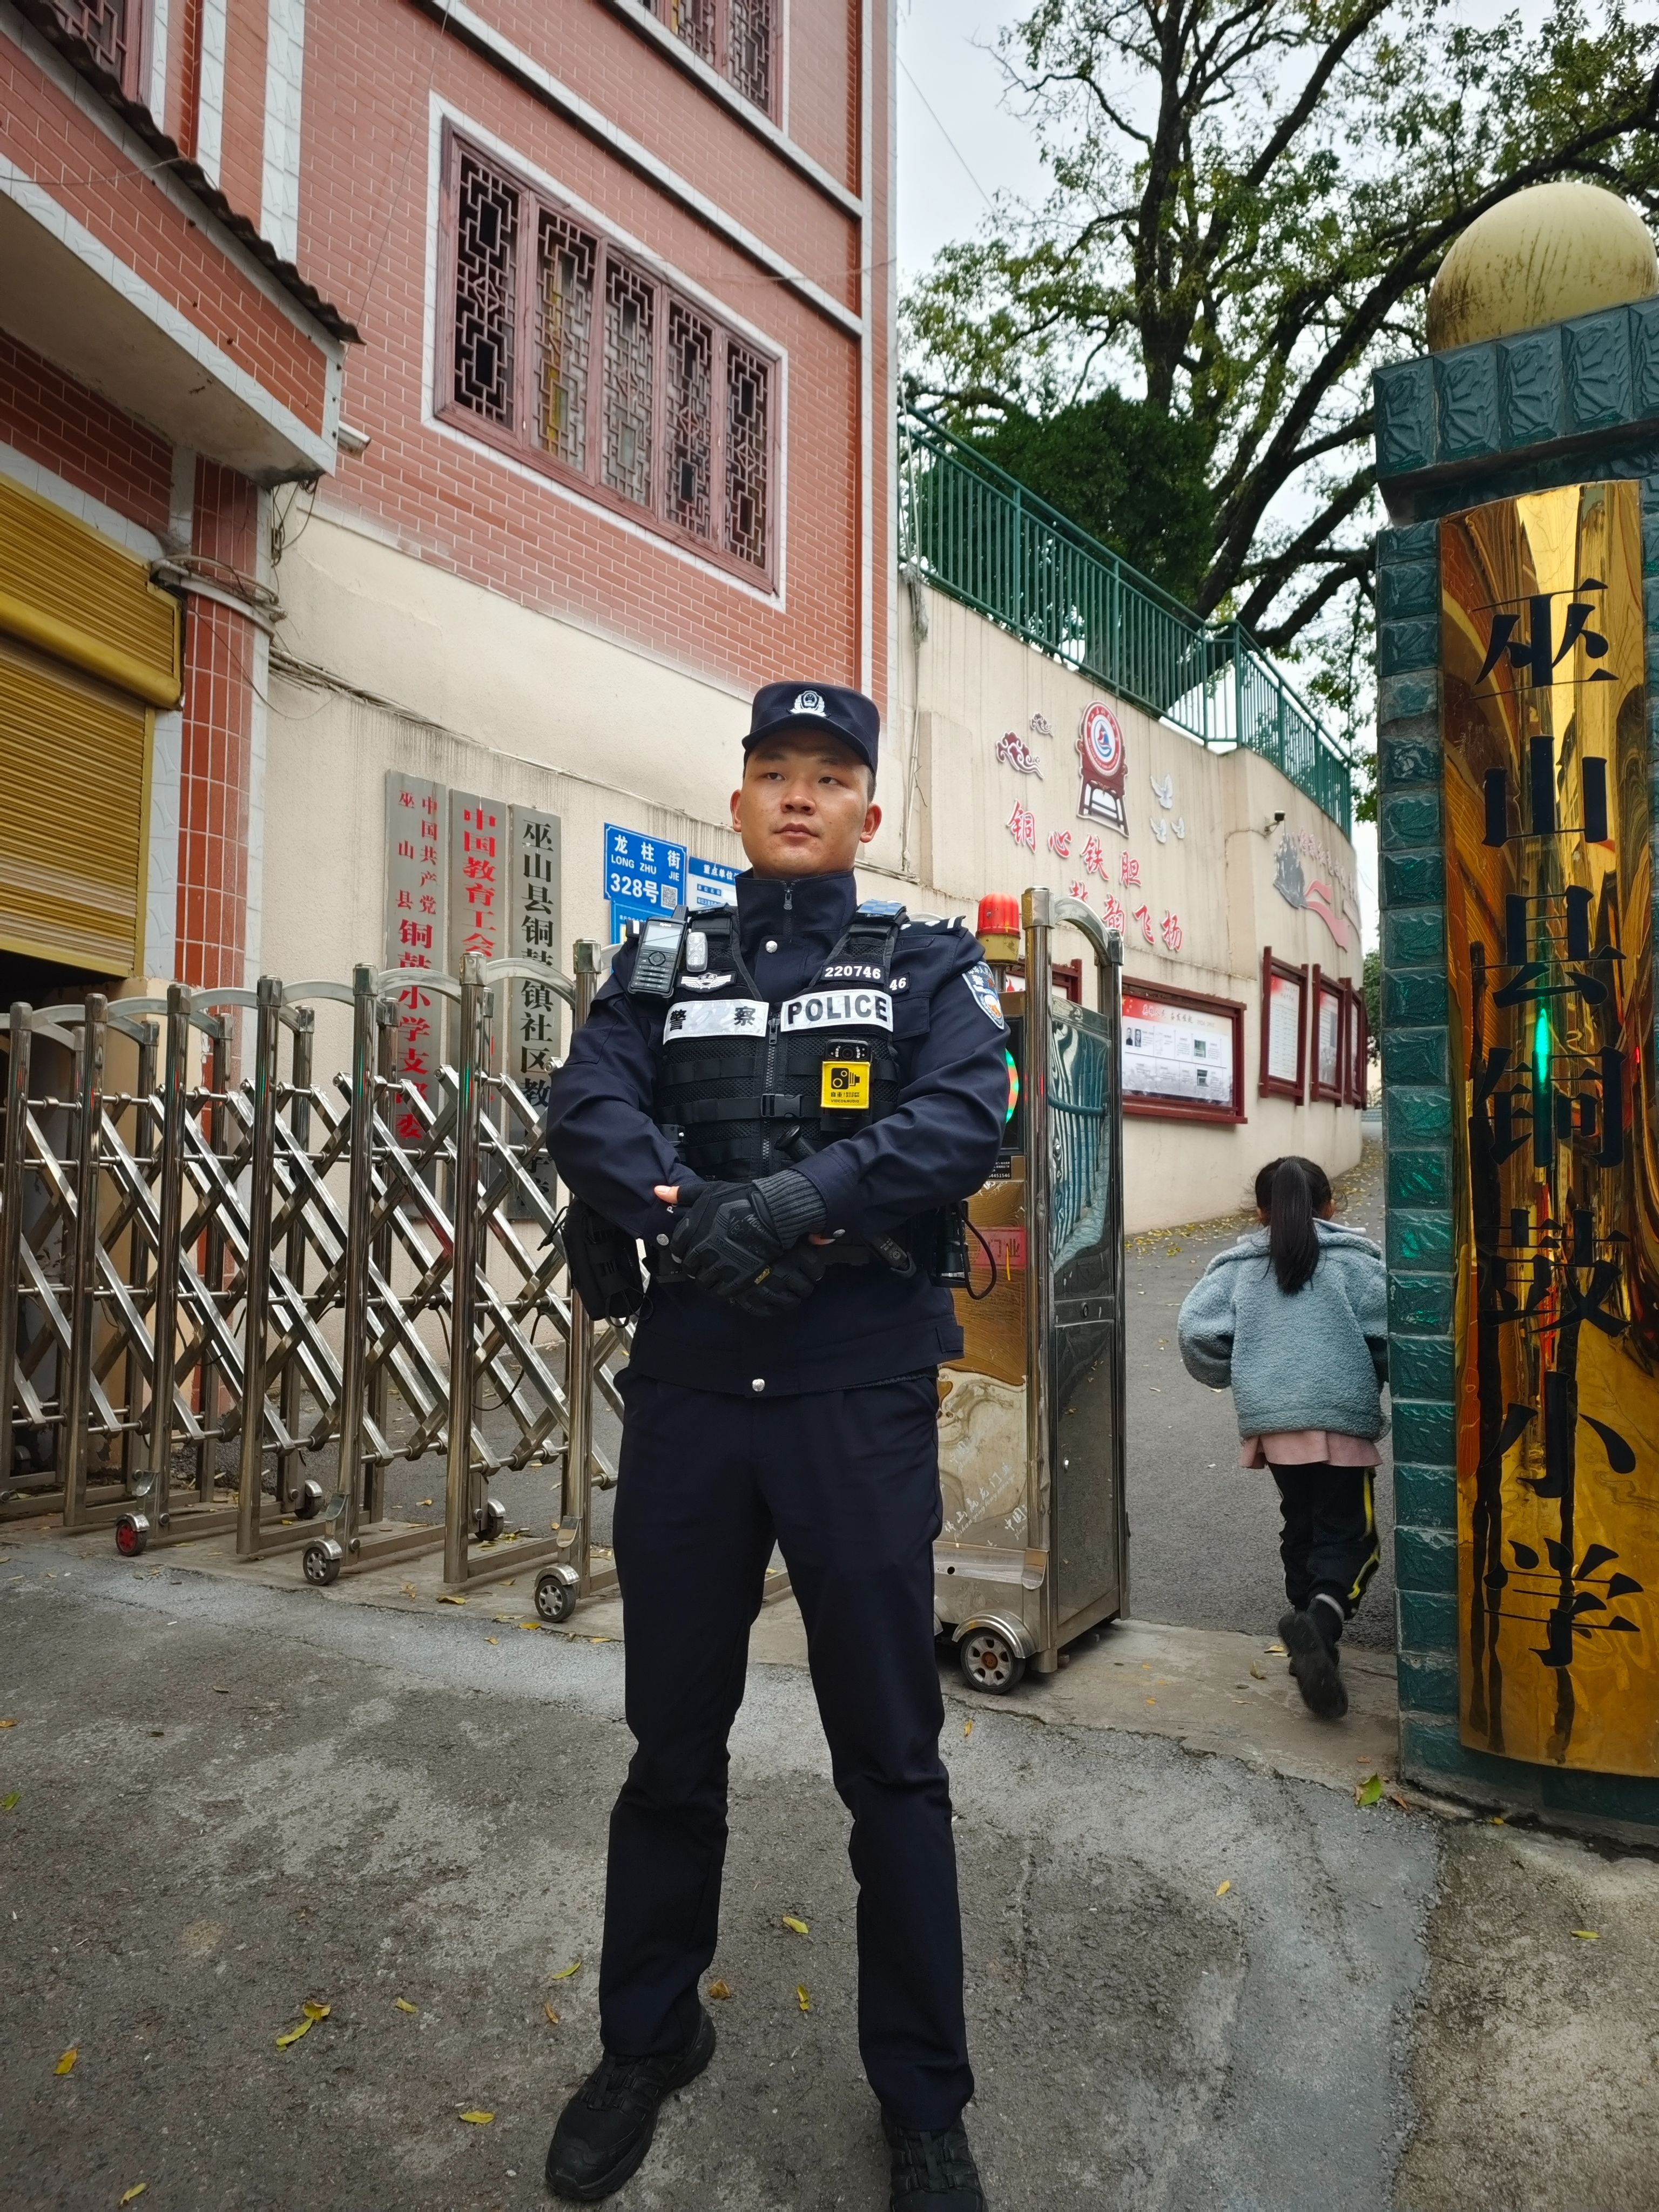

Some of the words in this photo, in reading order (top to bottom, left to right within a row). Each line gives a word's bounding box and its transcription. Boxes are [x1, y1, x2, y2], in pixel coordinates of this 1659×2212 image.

[396, 790, 415, 910] 巫山县
[420, 796, 437, 914] 中国共产党
[614, 835, 680, 869] 龙柱街
[1006, 799, 1142, 888] 铜心铁胆
[611, 854, 635, 868] LONG
[640, 862, 657, 874] ZHU
[669, 871, 680, 881] JIE
[703, 864, 741, 881] 重点单位
[611, 873, 659, 904] 328号
[825, 966, 881, 979] 220746
[670, 1006, 756, 1031] 警察
[787, 994, 887, 1024] POLICE
[1469, 578, 1643, 1667] 巫山县铜鼓小学
